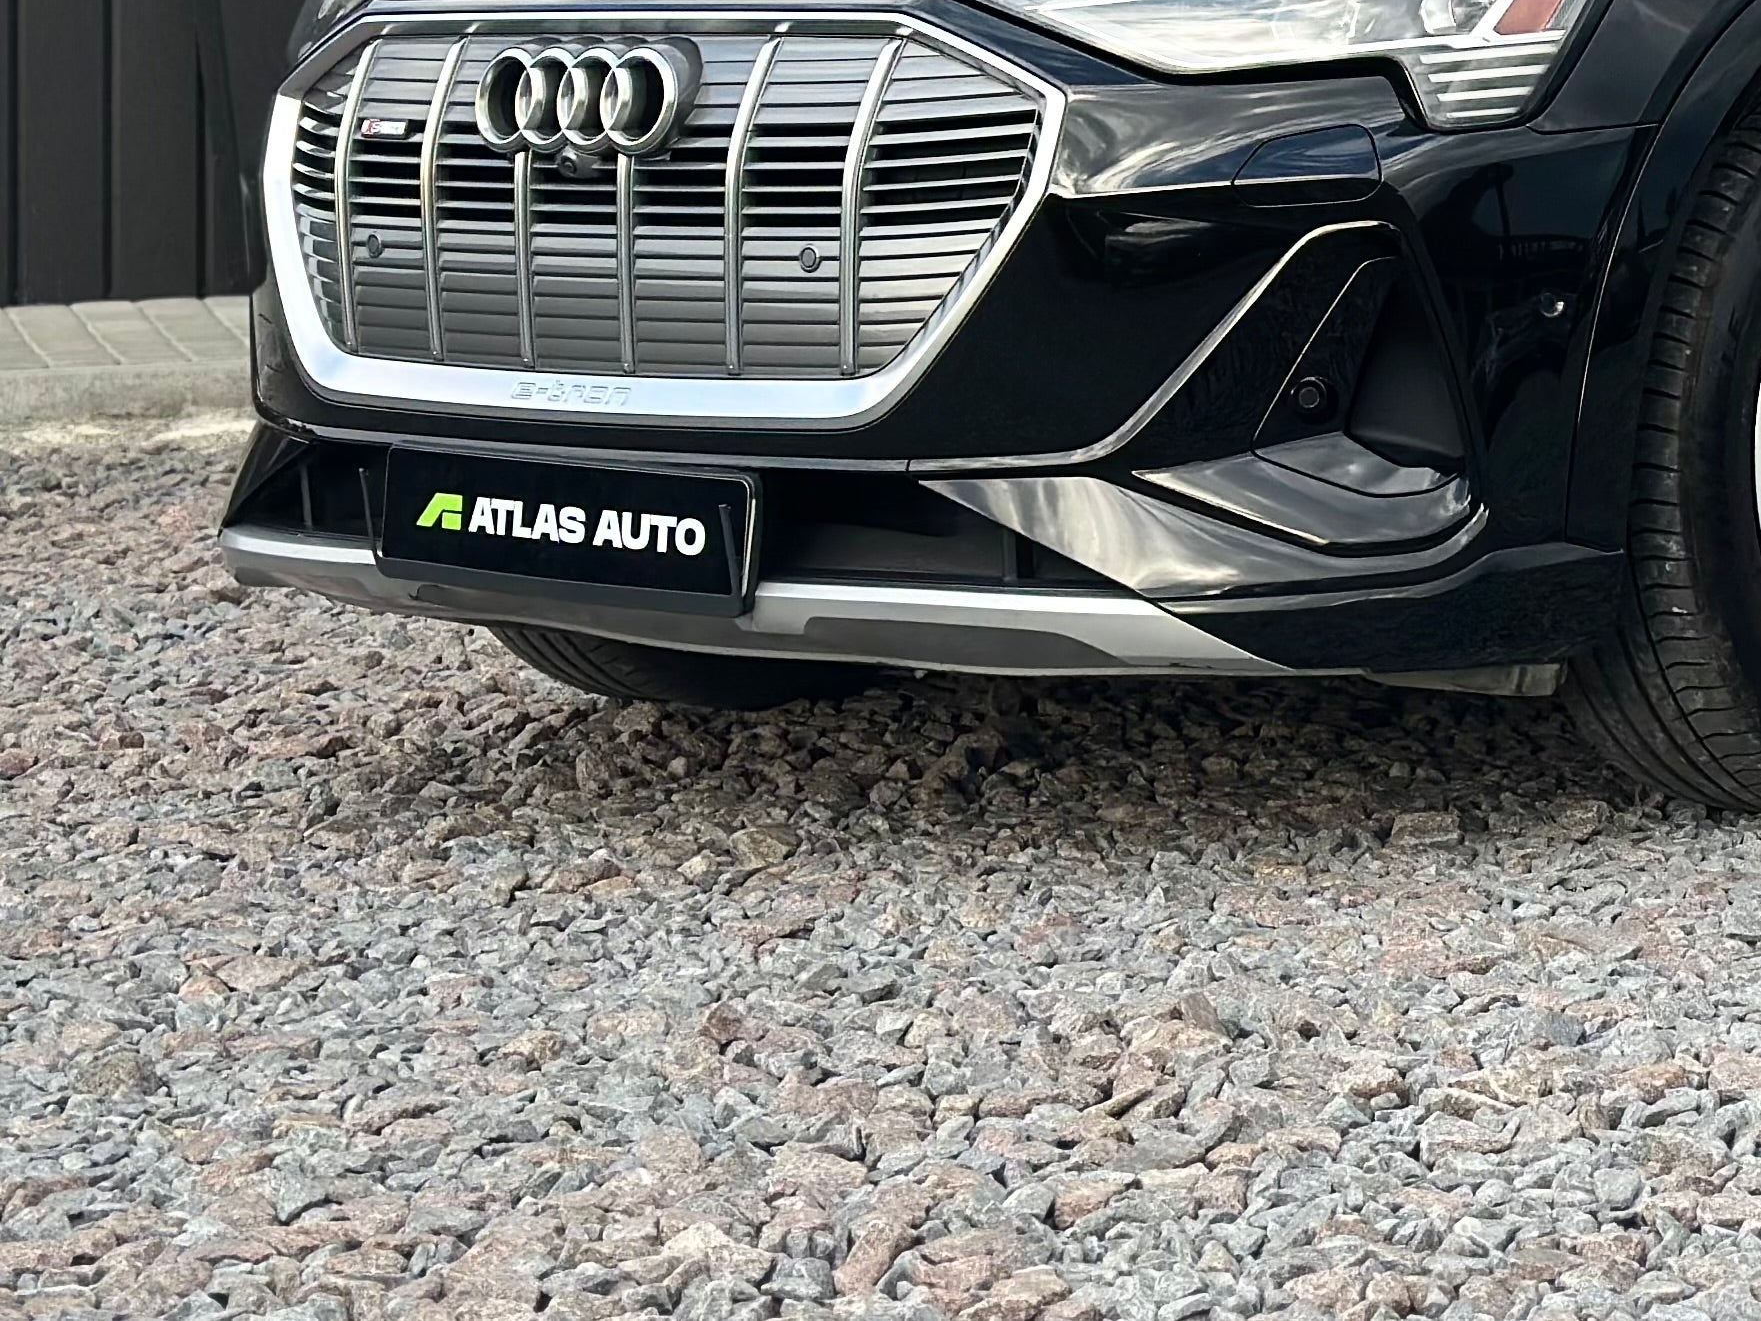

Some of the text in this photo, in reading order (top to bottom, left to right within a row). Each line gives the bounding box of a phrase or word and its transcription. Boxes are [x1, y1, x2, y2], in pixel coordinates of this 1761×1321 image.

[511, 380, 632, 407] e-tron
[467, 496, 706, 556] ATLAS AUTO
